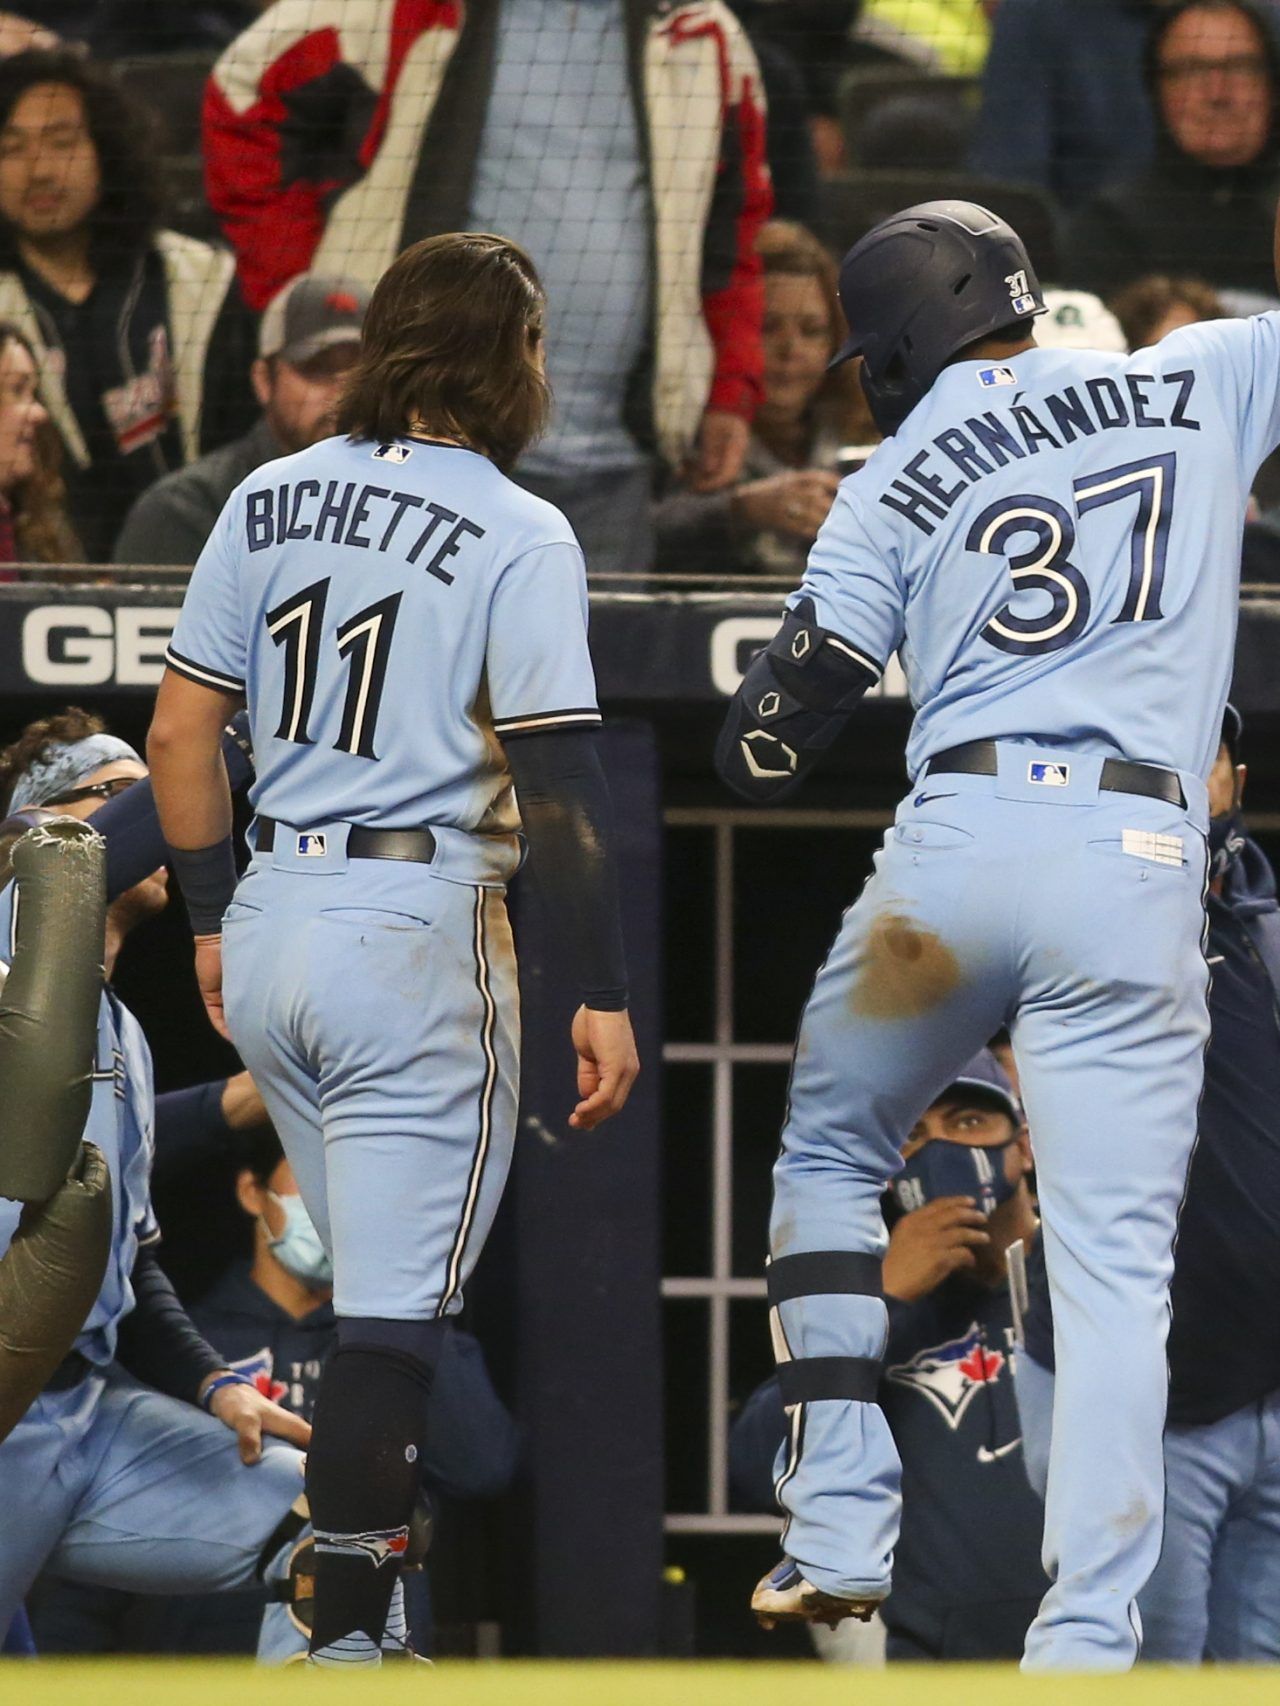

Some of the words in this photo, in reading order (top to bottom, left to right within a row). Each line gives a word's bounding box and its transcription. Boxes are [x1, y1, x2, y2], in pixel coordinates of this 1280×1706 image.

[1004, 269, 1029, 298] 37
[246, 480, 486, 586] BICHETTE
[879, 369, 1201, 537] HERNÁNDEZ
[965, 451, 1177, 656] 37
[265, 576, 404, 762] 11
